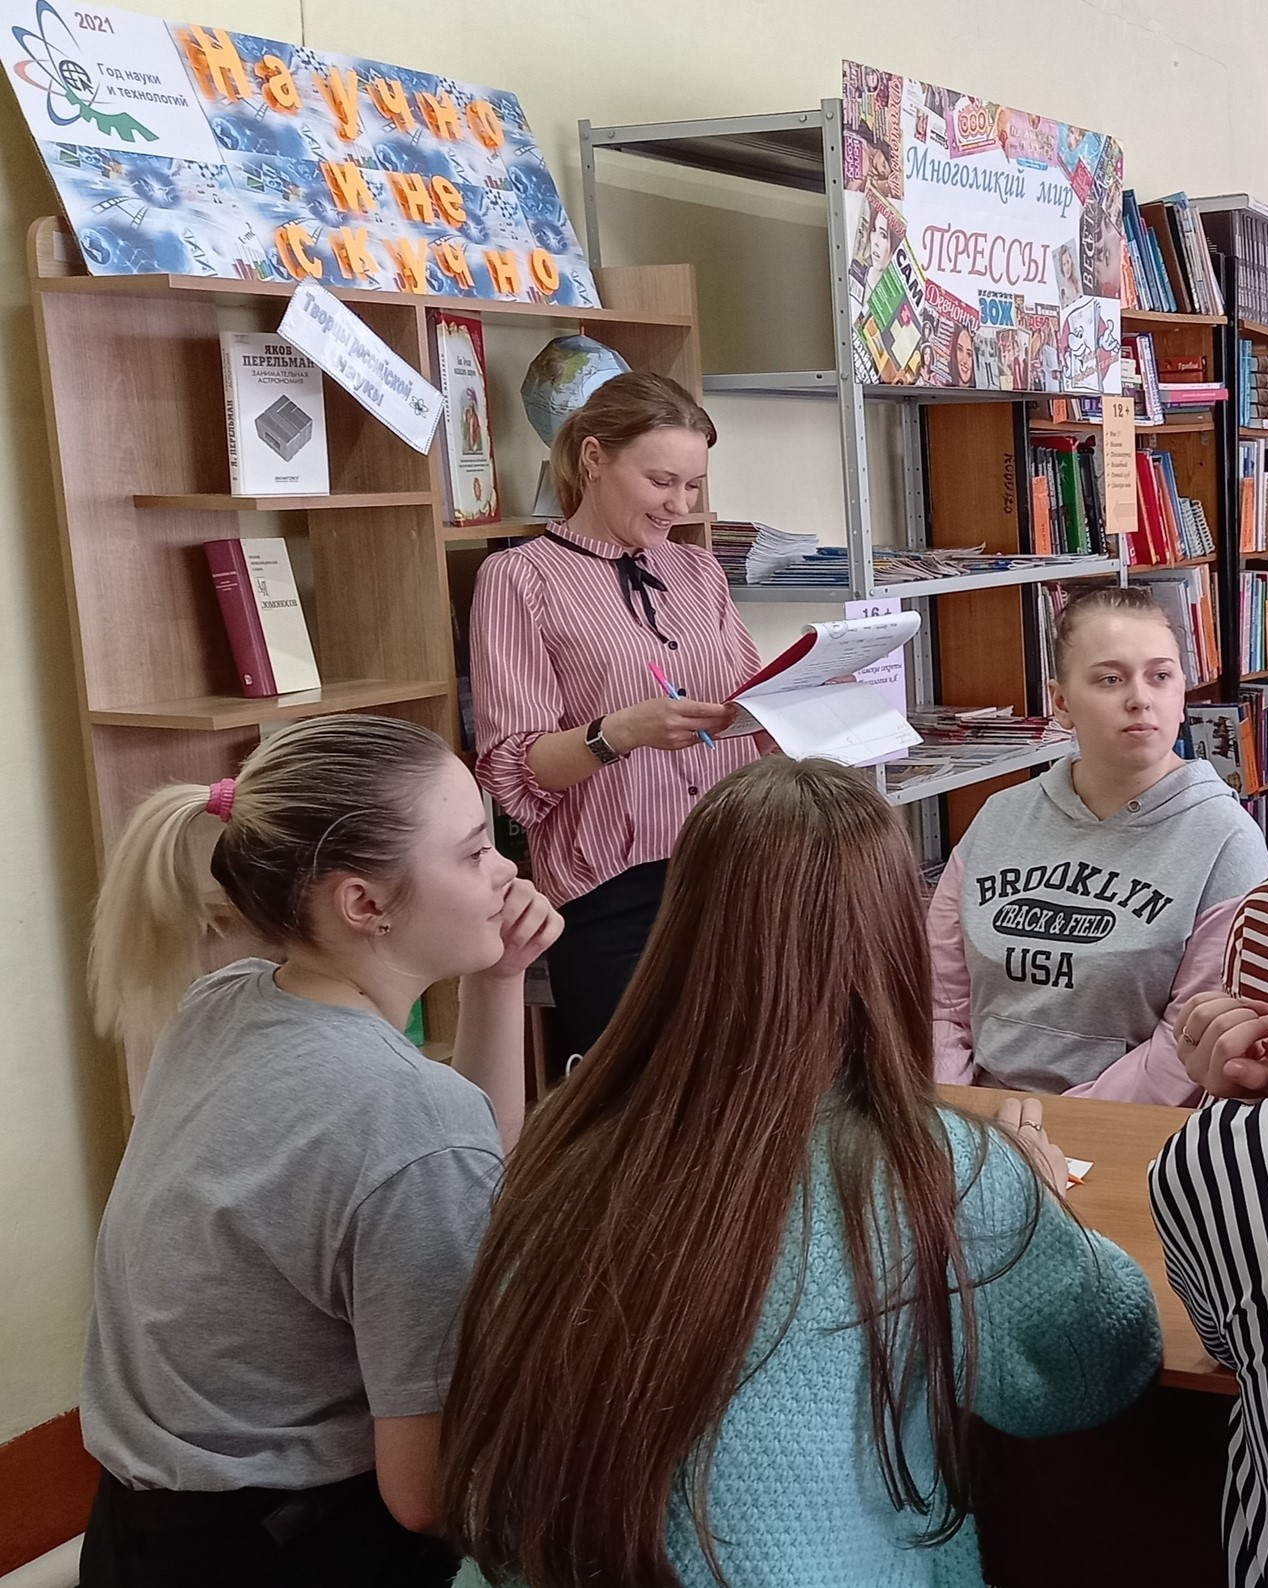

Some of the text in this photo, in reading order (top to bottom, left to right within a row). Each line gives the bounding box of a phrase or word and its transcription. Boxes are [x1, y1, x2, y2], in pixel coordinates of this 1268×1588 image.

[75, 12, 115, 34] 2021
[97, 63, 161, 87] Год науки
[107, 86, 188, 108] и технологий
[179, 25, 505, 149] Научно
[387, 171, 467, 227] не
[906, 146, 1026, 204] Многоликий
[1036, 180, 1074, 218] мир
[896, 249, 924, 307] САМ
[922, 223, 1051, 286] ПРЕССЫ
[927, 284, 979, 337] Девчонки
[979, 298, 1014, 326] ЗОЖ
[242, 355, 315, 368] ПЕРЕЛЬМАН
[264, 345, 292, 355] ЯКОБ
[302, 291, 351, 346] Творцы
[348, 337, 413, 401] российской
[1178, 361, 1199, 371] Грибы
[335, 354, 384, 407] науки
[976, 861, 1174, 925] BROOKLYN
[996, 904, 1115, 938] TRACK & FIELD
[1005, 947, 1074, 989] USA
